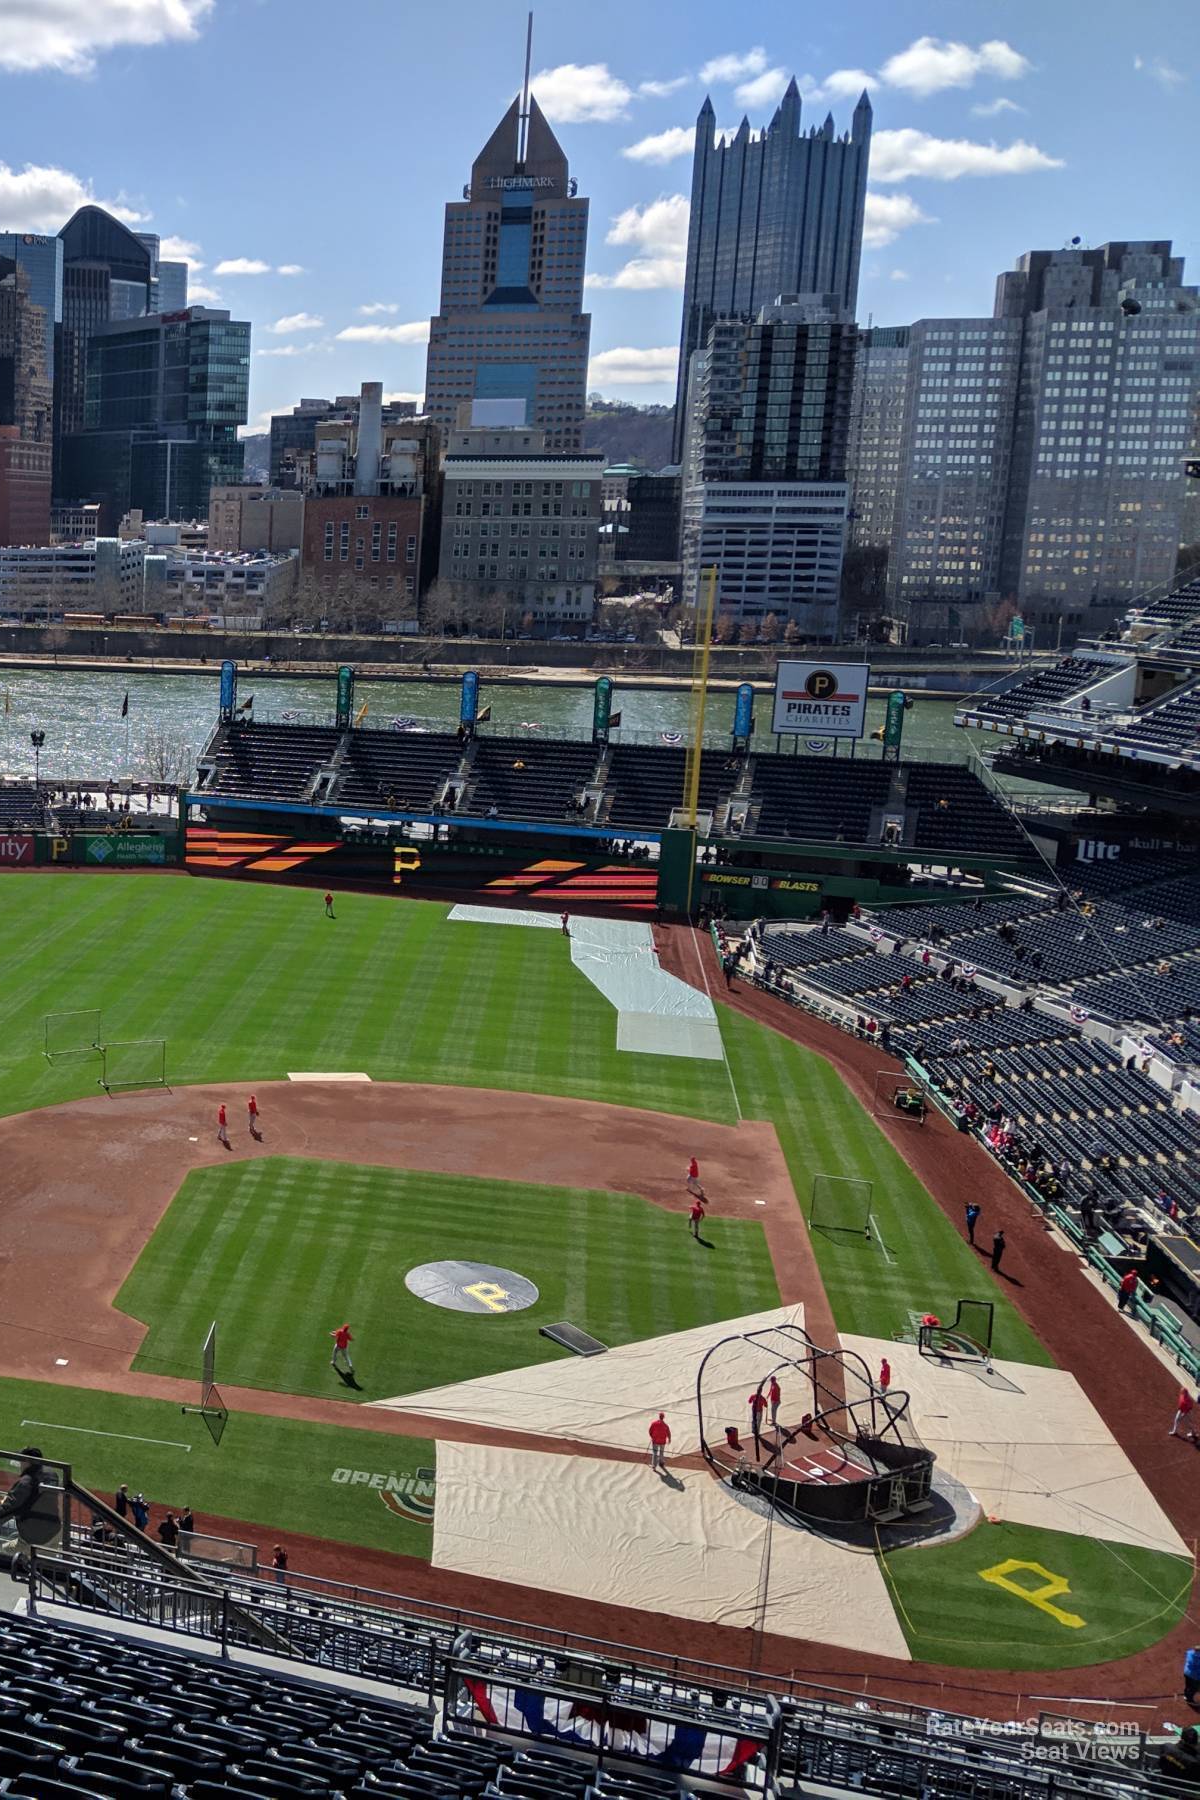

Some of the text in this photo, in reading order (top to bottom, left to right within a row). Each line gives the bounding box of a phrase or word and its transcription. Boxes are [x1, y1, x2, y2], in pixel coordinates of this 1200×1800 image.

[490, 176, 554, 188] HIGHMARK
[814, 676, 829, 695] P
[787, 702, 851, 716] PIRATES
[786, 714, 850, 726] CHARITIES
[52, 839, 68, 860] P
[116, 842, 165, 853] Allegheny
[1076, 838, 1121, 864] Lite
[393, 846, 421, 884] P
[708, 874, 751, 885] BOWSER
[778, 880, 819, 891] BLASTS
[977, 1558, 1088, 1629] P
